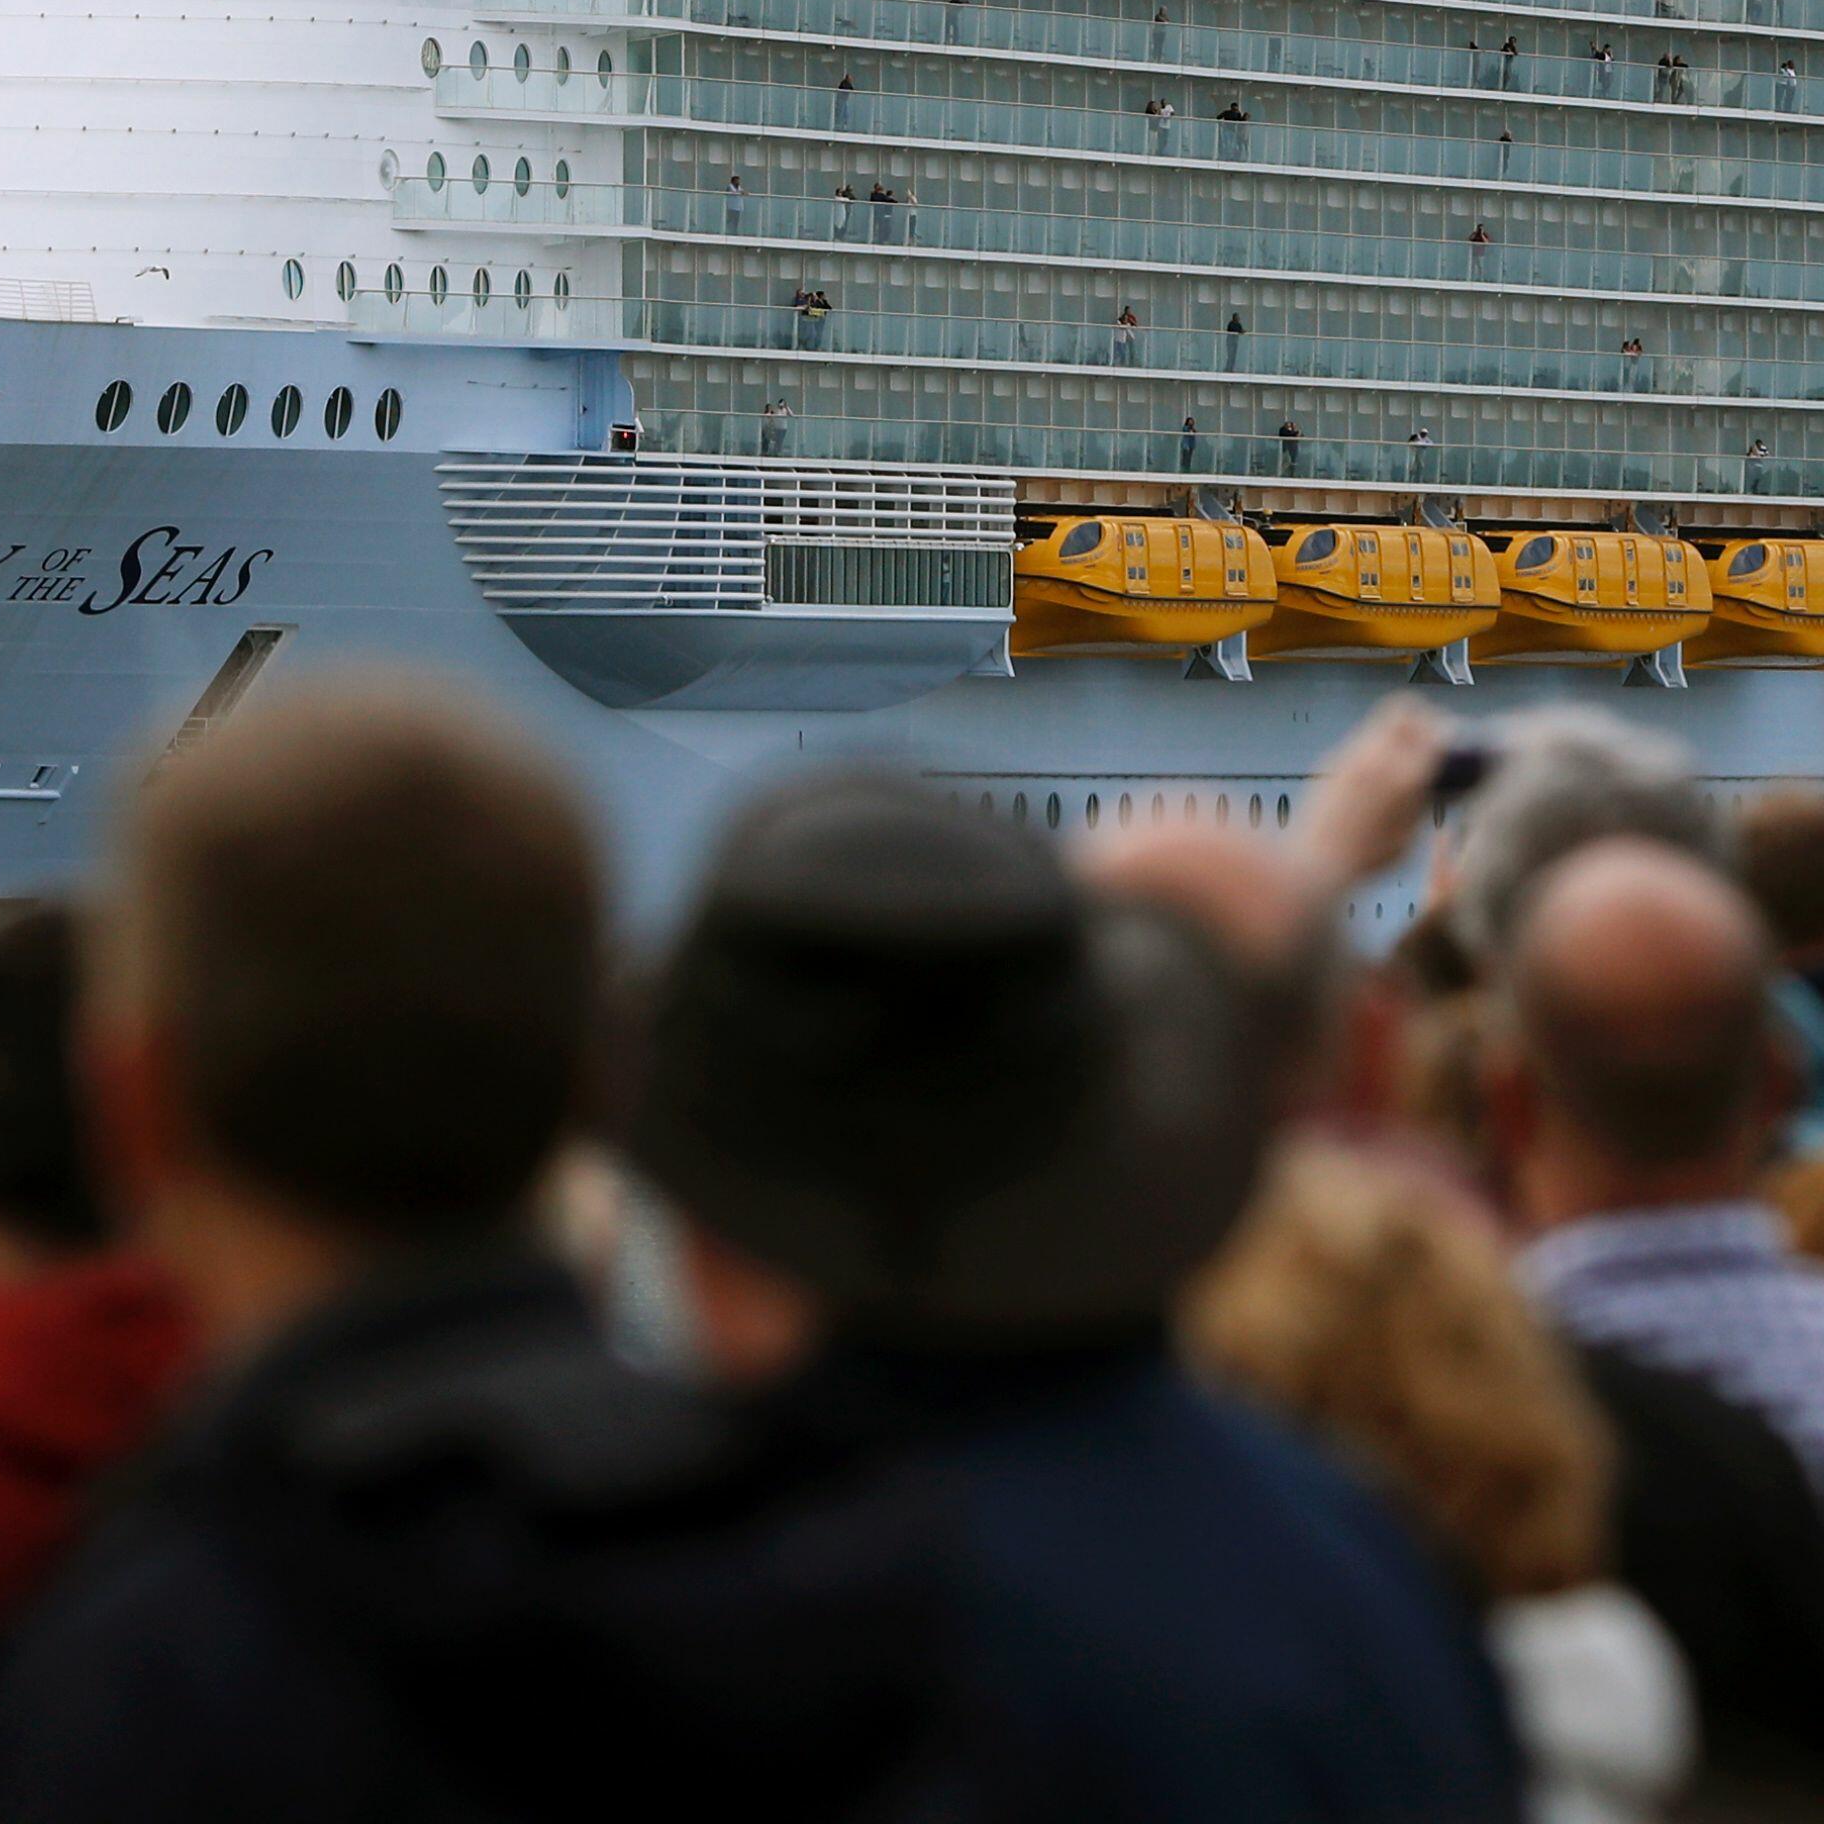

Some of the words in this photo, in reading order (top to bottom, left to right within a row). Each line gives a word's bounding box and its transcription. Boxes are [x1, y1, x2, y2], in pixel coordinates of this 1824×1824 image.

[41, 547, 93, 573] OF
[77, 525, 274, 616] SEAS
[6, 575, 86, 602] THE
